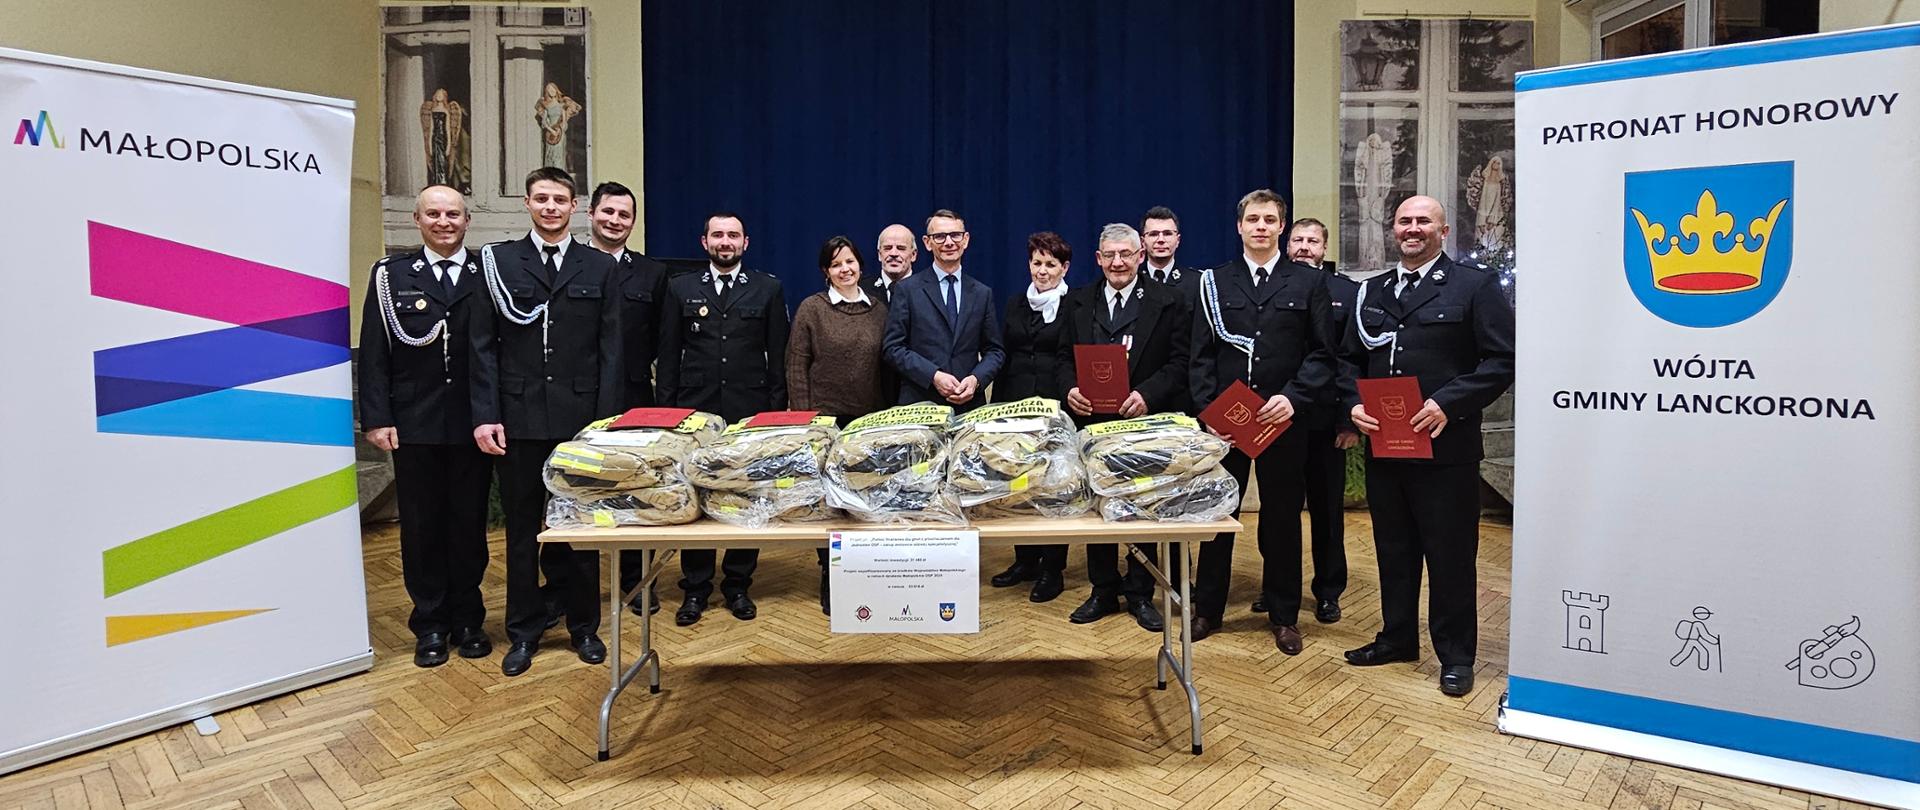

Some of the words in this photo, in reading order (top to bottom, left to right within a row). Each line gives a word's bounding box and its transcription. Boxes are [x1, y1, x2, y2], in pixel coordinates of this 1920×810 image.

[1543, 114, 1686, 145] PATRONAT
[1696, 93, 1899, 132] HONOROWY
[80, 127, 322, 175] MAŁOPOLSKA
[1653, 354, 1756, 380] WÓJTA
[1552, 390, 1648, 412] GMINY
[1656, 393, 1876, 420] LANCKORONA
